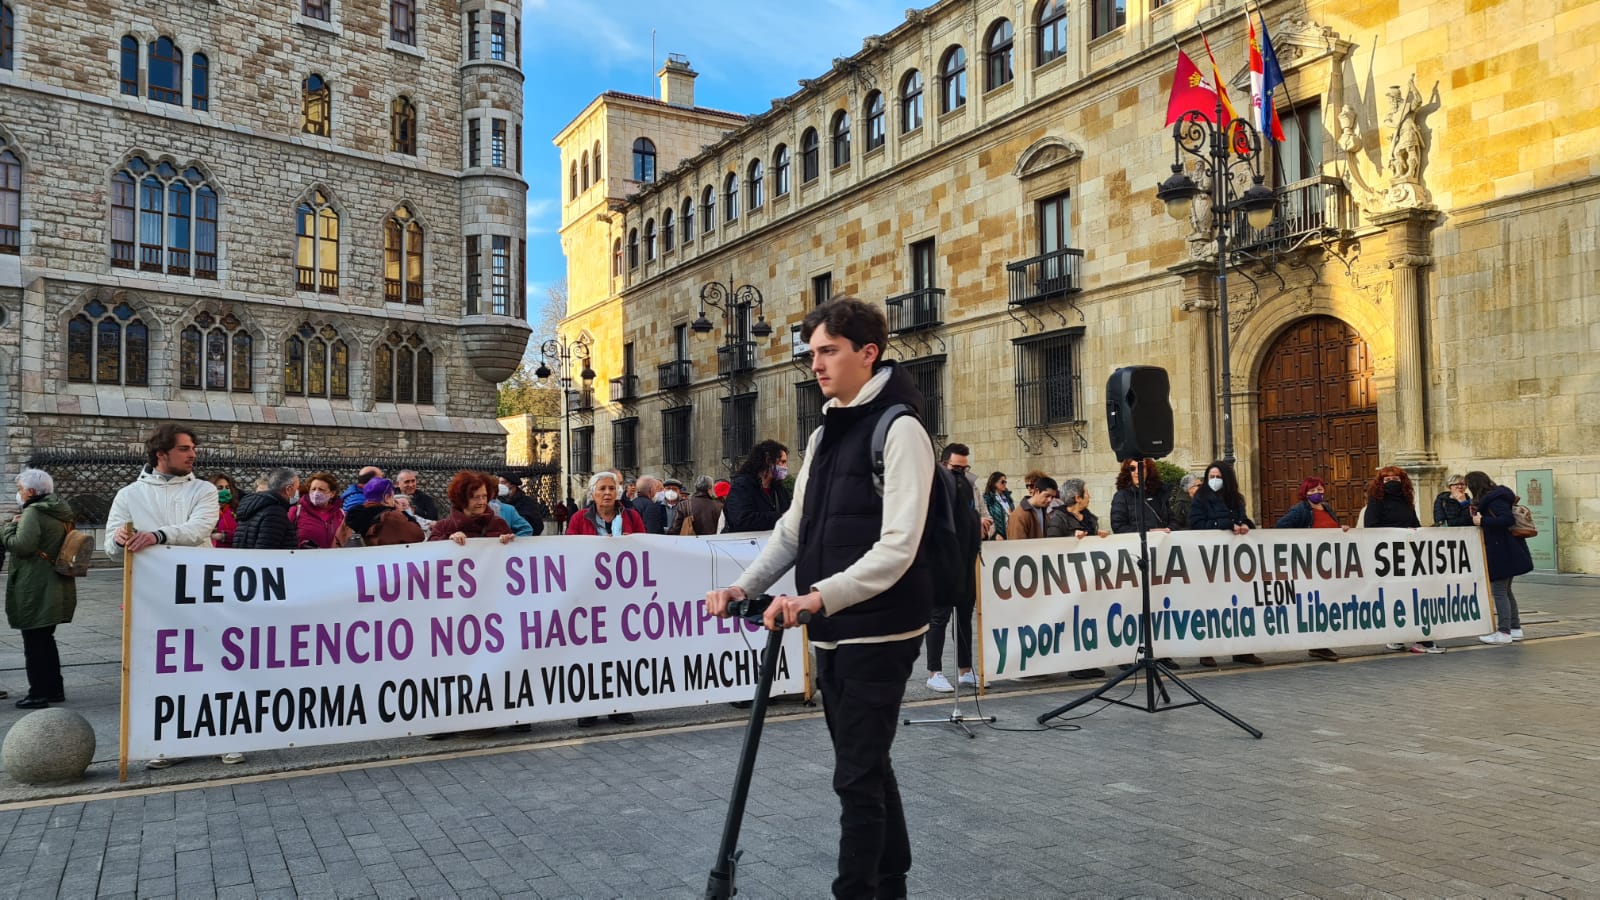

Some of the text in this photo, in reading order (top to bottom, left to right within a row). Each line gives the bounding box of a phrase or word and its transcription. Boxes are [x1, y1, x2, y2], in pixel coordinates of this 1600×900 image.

[175, 564, 286, 604] LEON
[355, 551, 657, 603] LUNES SIN SOL
[992, 540, 1471, 600] CONTRA LA VIOLENCIA SEXISTA
[1254, 580, 1296, 607] LEON
[156, 592, 788, 673] EL SILENCIO NOS HACE CÓMPL
[992, 628, 1009, 674] y
[1017, 621, 1065, 671] por
[1073, 605, 1098, 652] la
[1264, 604, 1289, 635] en
[1296, 587, 1386, 633] Libertad
[1393, 599, 1406, 628] e
[1412, 582, 1481, 637] Igualdad
[154, 646, 790, 741] PLATAFORMA CONTRA LA VIOLENCIA MACHIA
